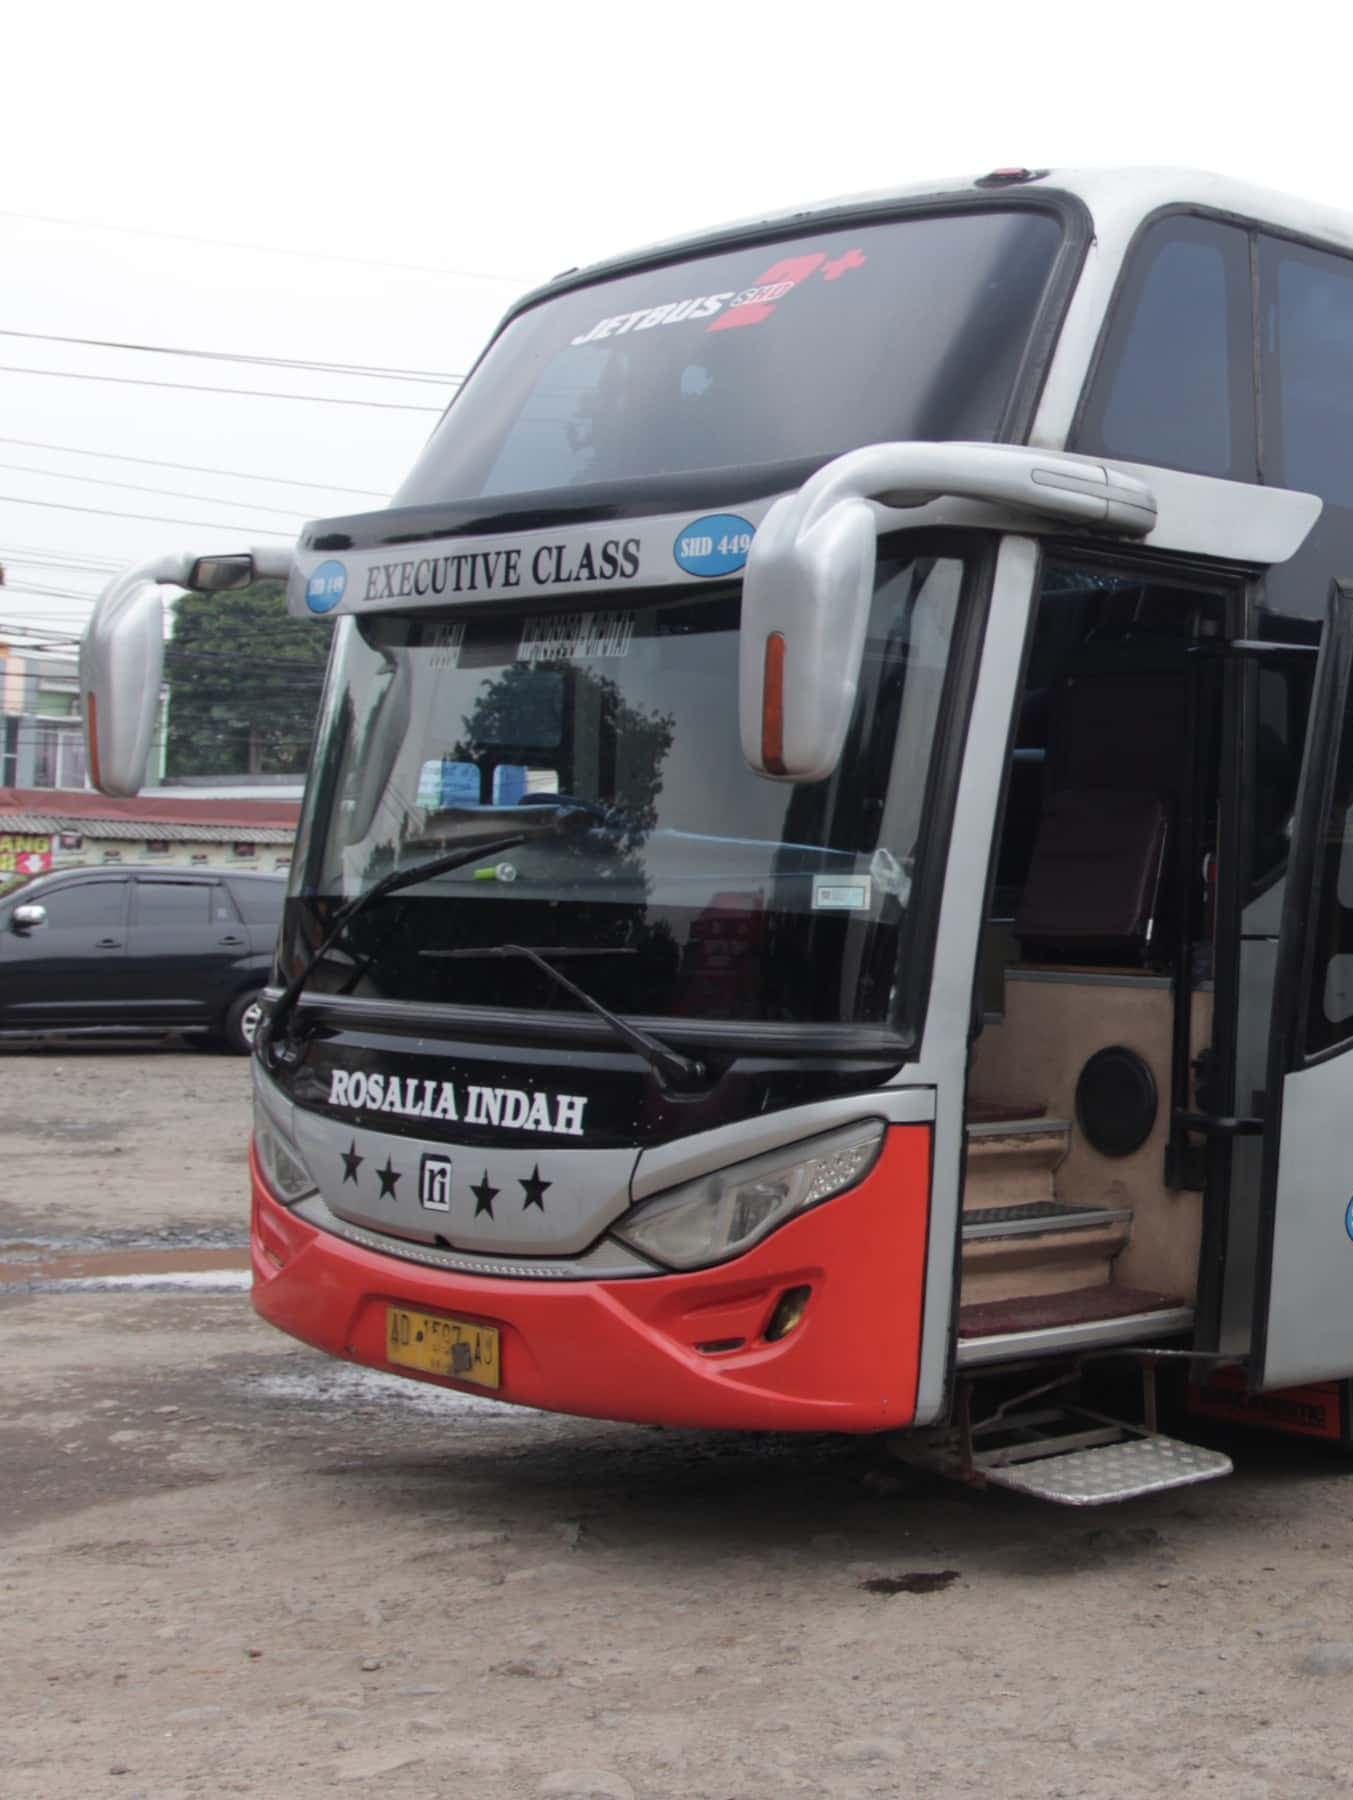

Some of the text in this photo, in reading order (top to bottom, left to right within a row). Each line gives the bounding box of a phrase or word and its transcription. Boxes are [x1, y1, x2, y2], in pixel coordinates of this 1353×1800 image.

[570, 291, 735, 345] JETBUS
[363, 537, 642, 601] EXECUTIVE CLASS
[680, 533, 751, 558] SHD 449
[328, 1069, 588, 1136] ROSALIA INDAH
